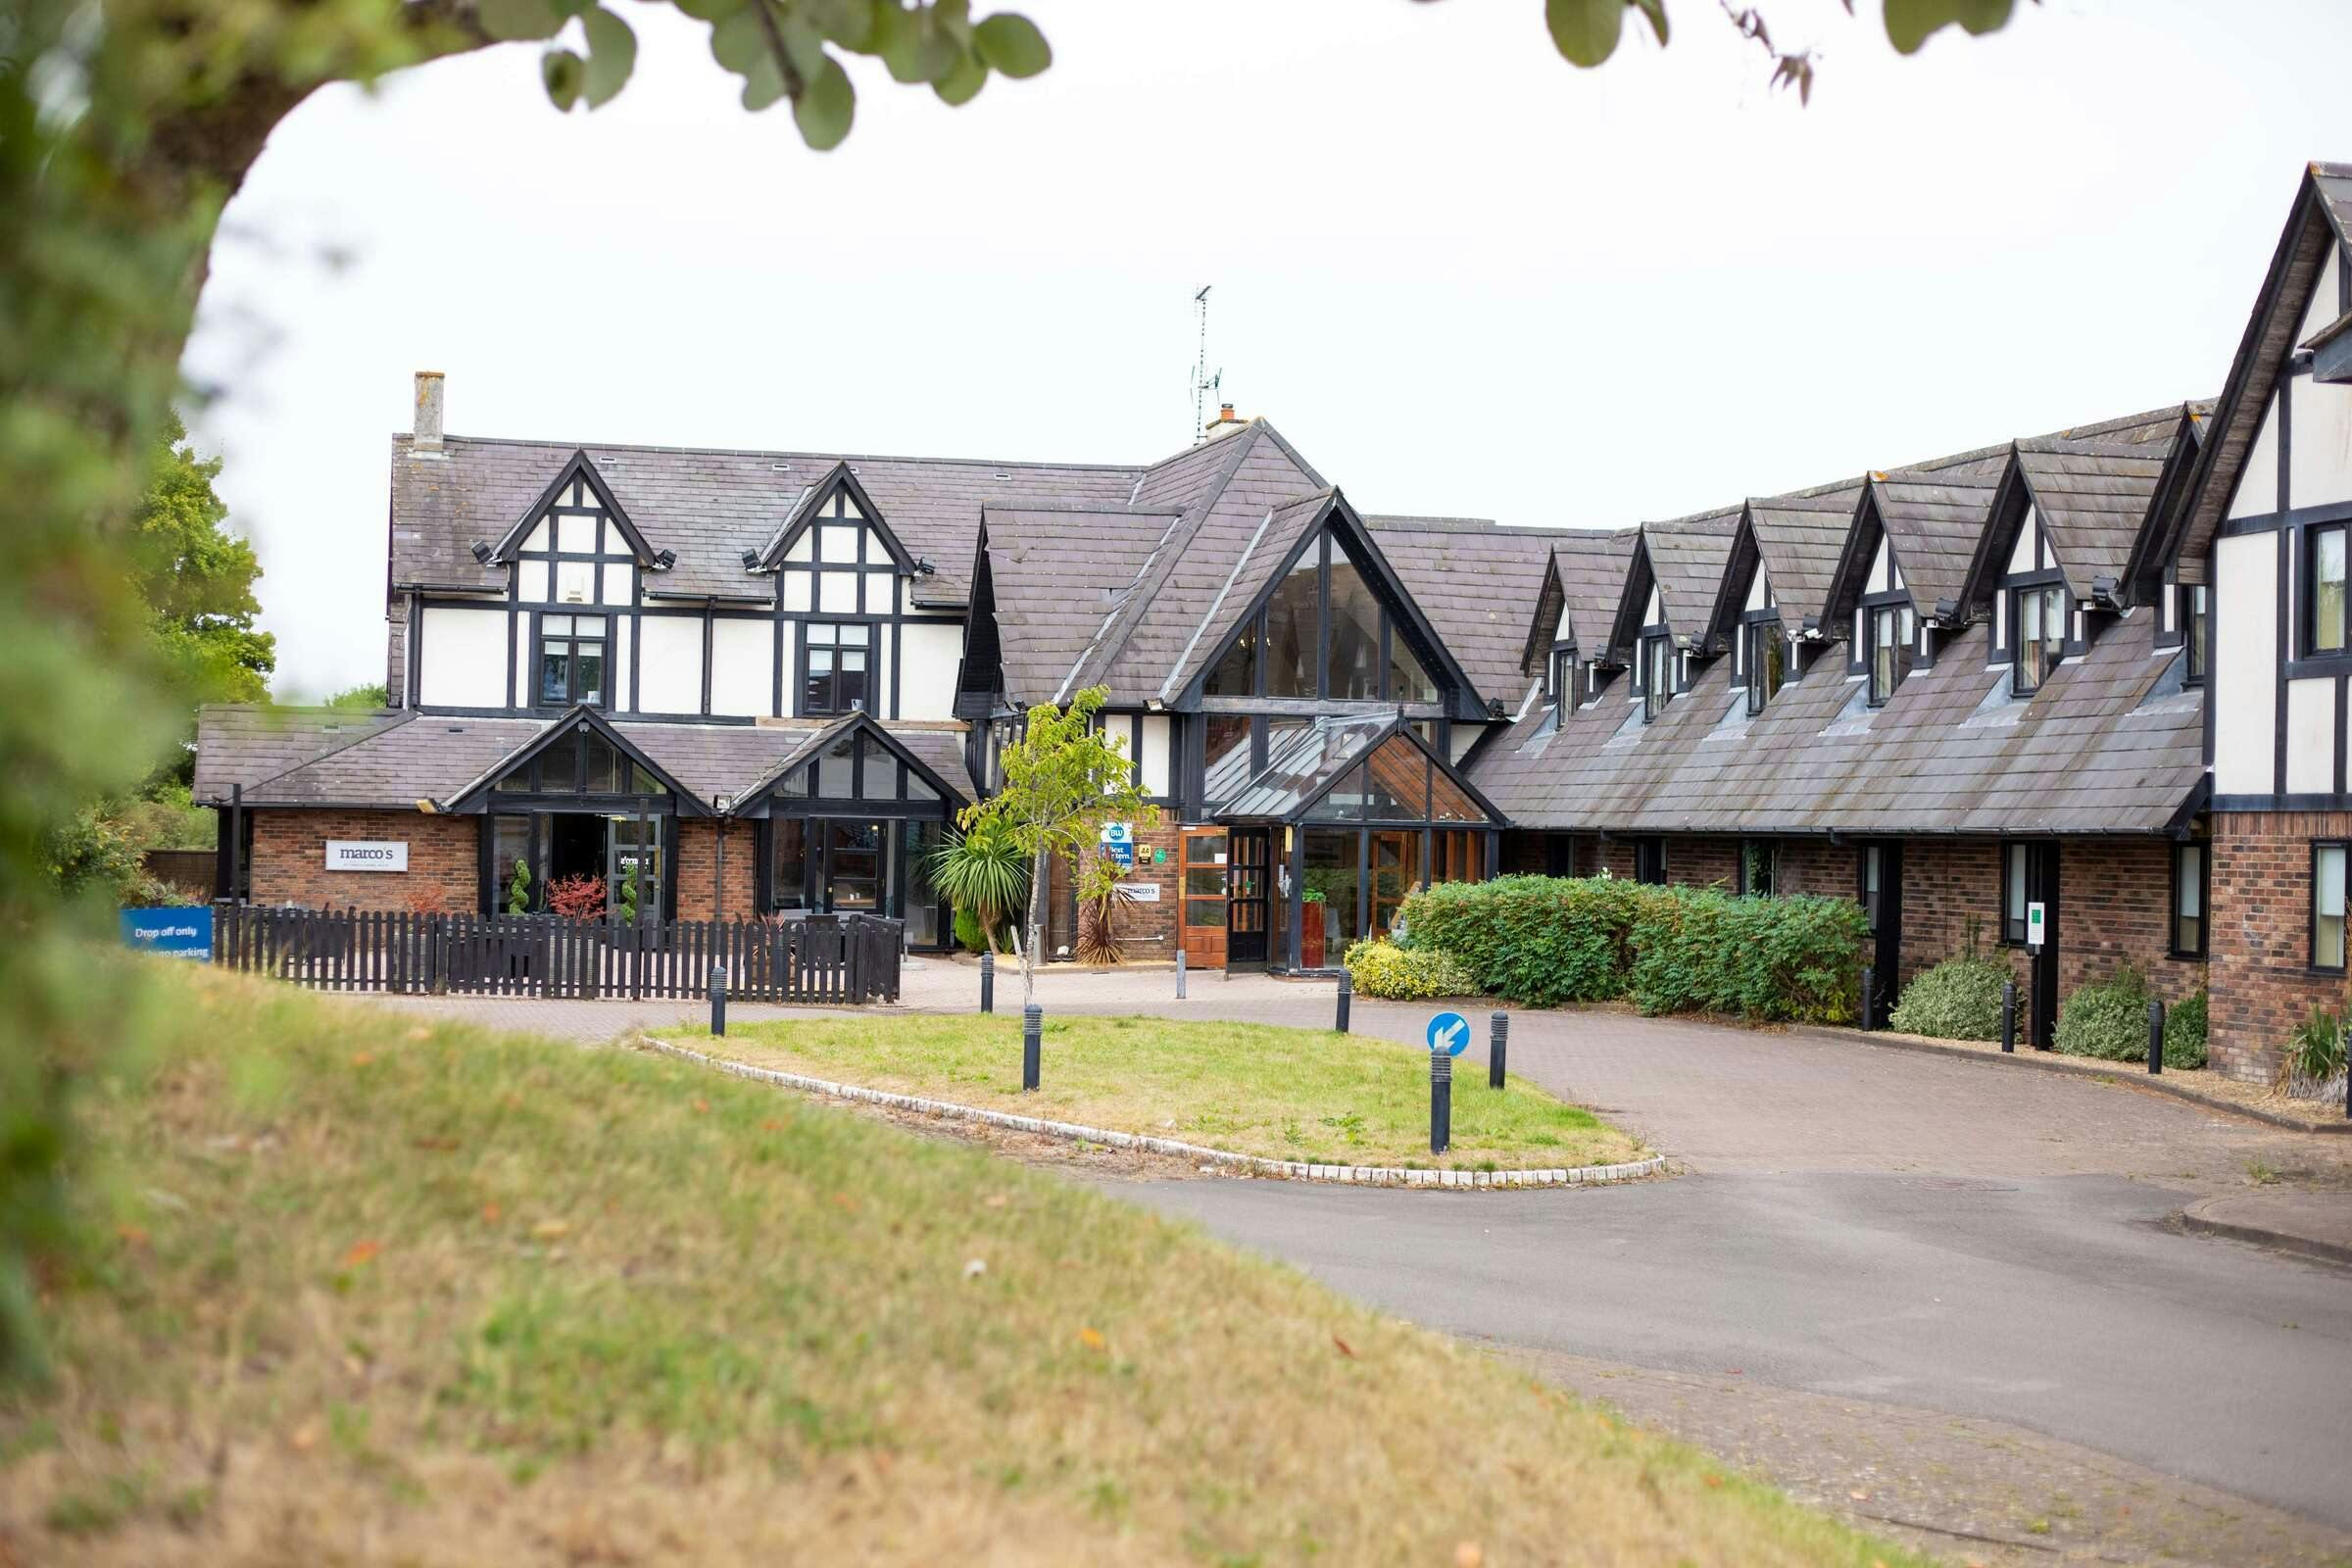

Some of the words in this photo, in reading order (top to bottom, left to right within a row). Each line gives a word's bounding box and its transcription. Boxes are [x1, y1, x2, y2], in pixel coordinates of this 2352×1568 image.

[340, 847, 393, 859] marco's
[135, 928, 159, 939] Drop
[161, 926, 175, 936] off
[175, 926, 197, 937] only
[172, 948, 209, 958] parking
